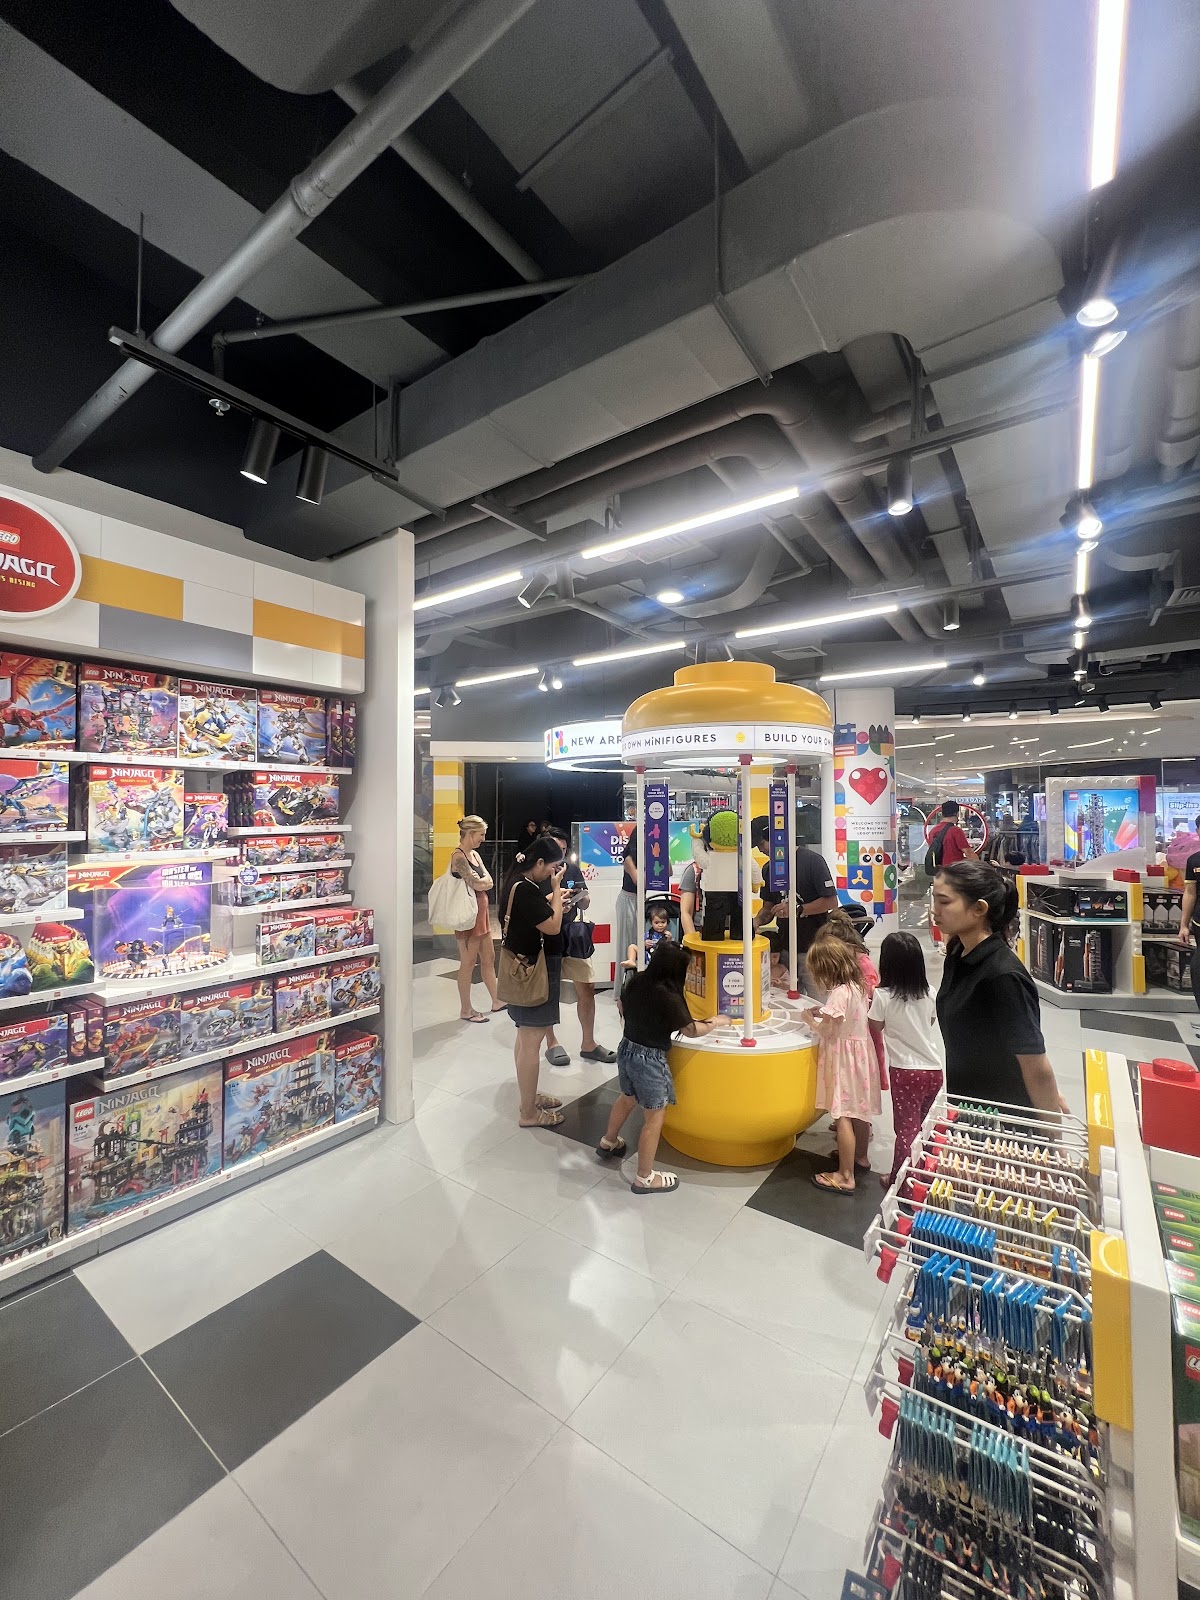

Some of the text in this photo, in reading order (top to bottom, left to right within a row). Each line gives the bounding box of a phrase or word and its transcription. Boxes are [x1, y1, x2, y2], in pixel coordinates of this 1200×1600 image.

[0, 530, 19, 544] EGO
[9, 576, 36, 588] RISING
[195, 683, 235, 698] NINJAGO
[274, 693, 307, 706] NINJAGO
[571, 736, 595, 747] NEW
[628, 740, 641, 750] OWN
[764, 733, 798, 743] BUILD
[802, 734, 822, 745] YOUR
[109, 768, 156, 779] NINJAGO
[268, 774, 302, 784] NINJAGO
[611, 846, 625, 855] UP
[610, 855, 625, 864] TO
[77, 870, 110, 880] NINJAGO
[288, 971, 316, 985] NINJAGO
[195, 990, 231, 1006] NINJAGO
[121, 1000, 165, 1018] NINJAGO
[245, 1047, 291, 1073] NINJAGO
[98, 1085, 161, 1117] NINJAGO
[75, 1106, 94, 1119] LEGO
[74, 1123, 90, 1133] 14+
[1157, 1185, 1177, 1194] LEGO
[1164, 1209, 1185, 1219] LEGO
[1171, 1238, 1194, 1248] LEGO
[1172, 1266, 1197, 1278] LEGO
